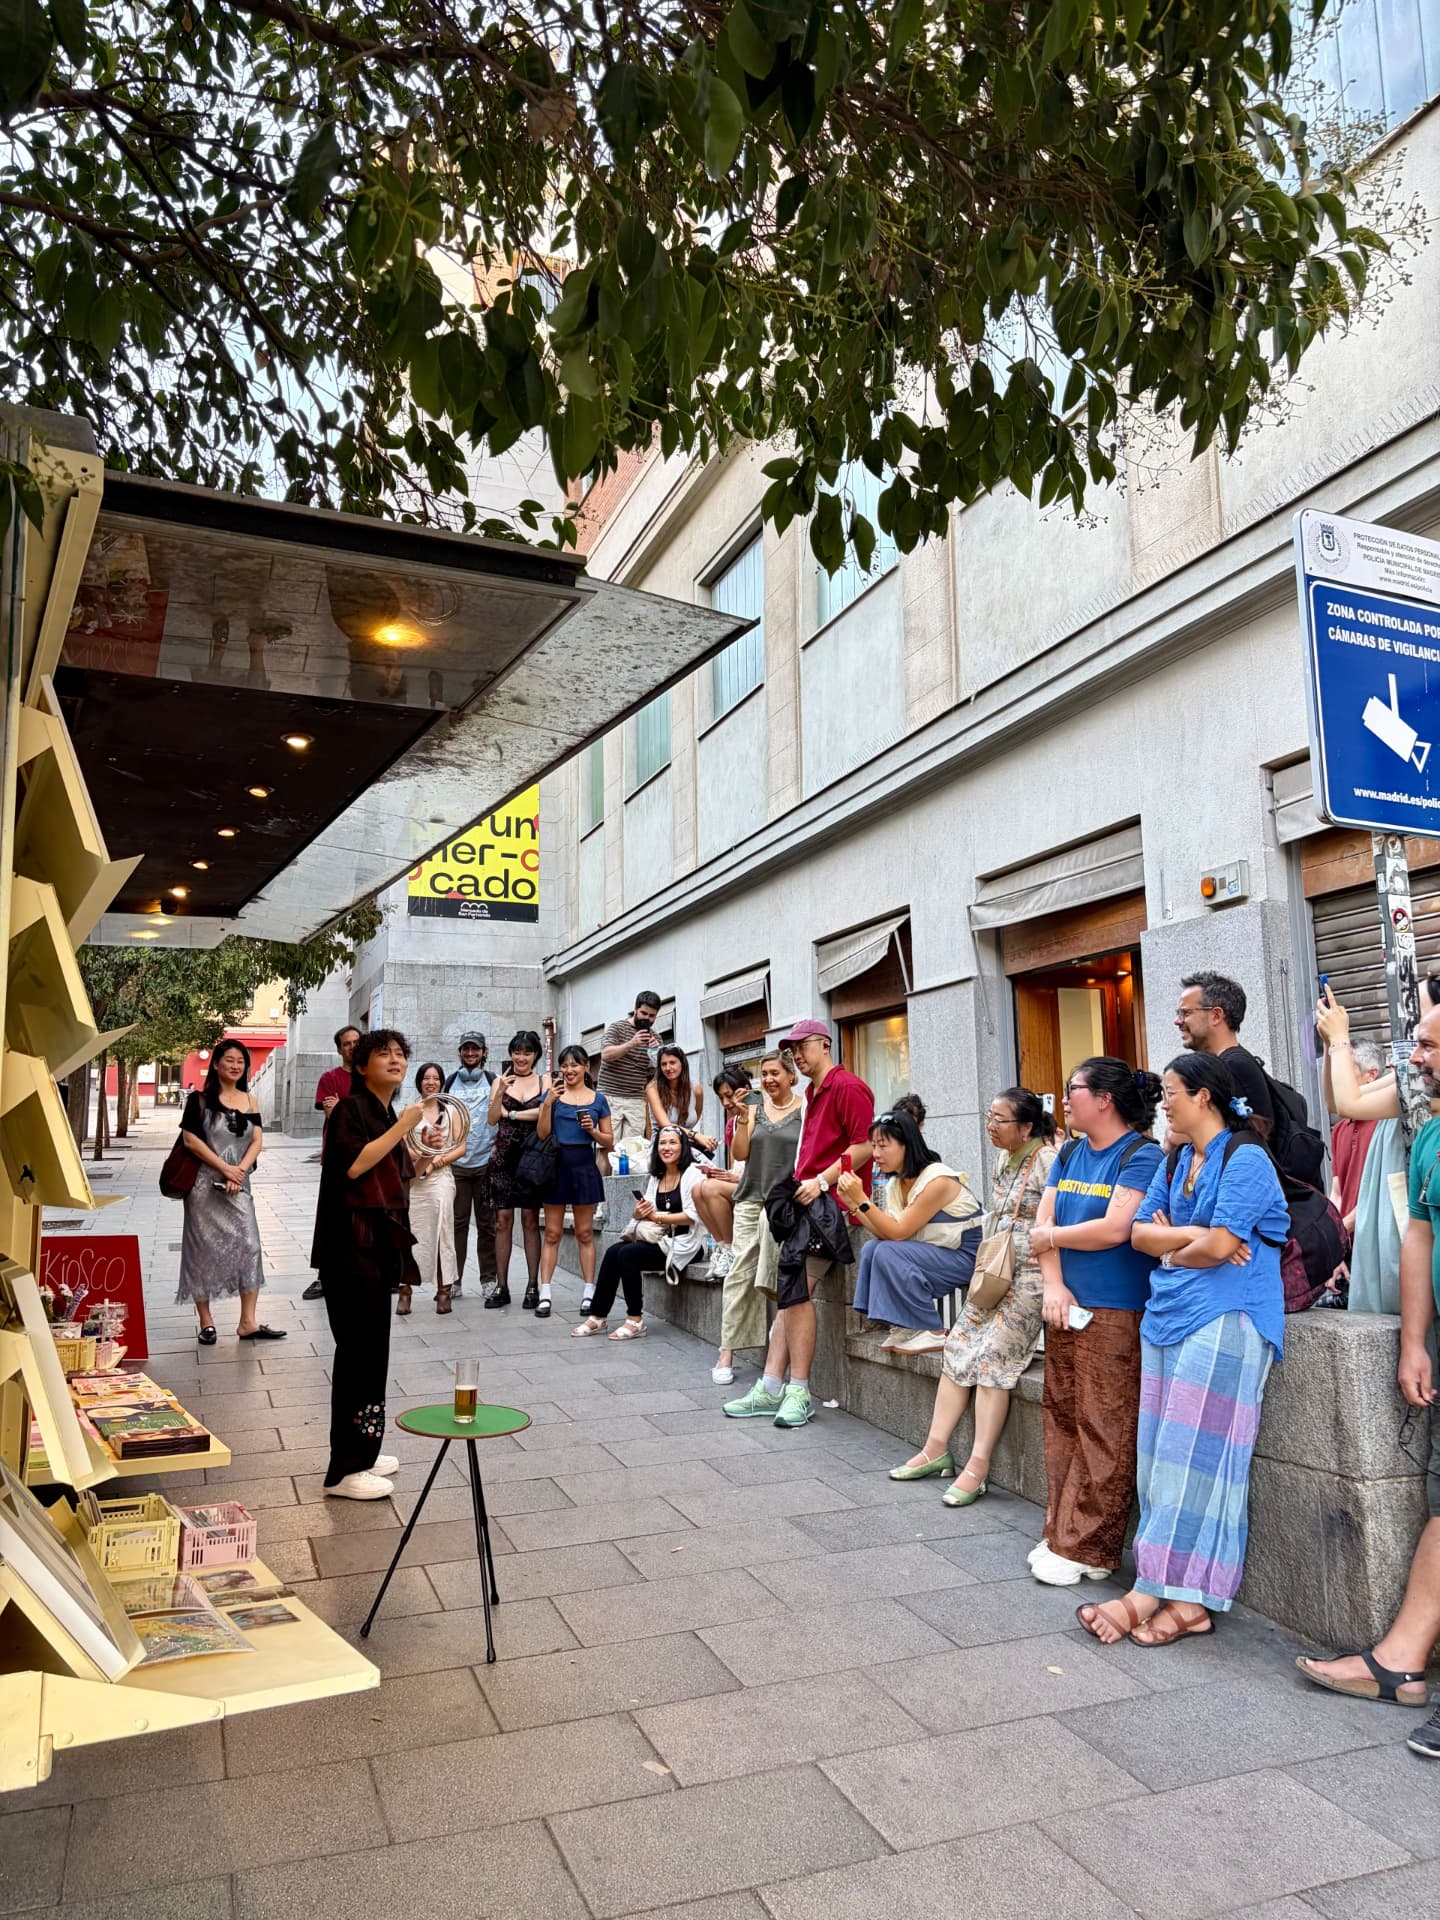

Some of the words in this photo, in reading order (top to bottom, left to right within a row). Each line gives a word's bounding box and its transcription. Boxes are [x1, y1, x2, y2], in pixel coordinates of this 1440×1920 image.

[1353, 532, 1388, 546] PROTECCIÓN
[1388, 540, 1396, 549] DE
[1396, 542, 1413, 553] DATOS
[1356, 542, 1390, 555] Responsable
[1363, 553, 1385, 565] POLICÍA
[1386, 558, 1414, 572] MUNICIPAL
[1414, 565, 1422, 574] DE
[1327, 601, 1356, 621] ZONA
[1357, 609, 1422, 636] CONTROLADA
[1328, 625, 1376, 649] CÁMARAS
[1377, 637, 1392, 652] DE
[429, 868, 537, 901] cado
